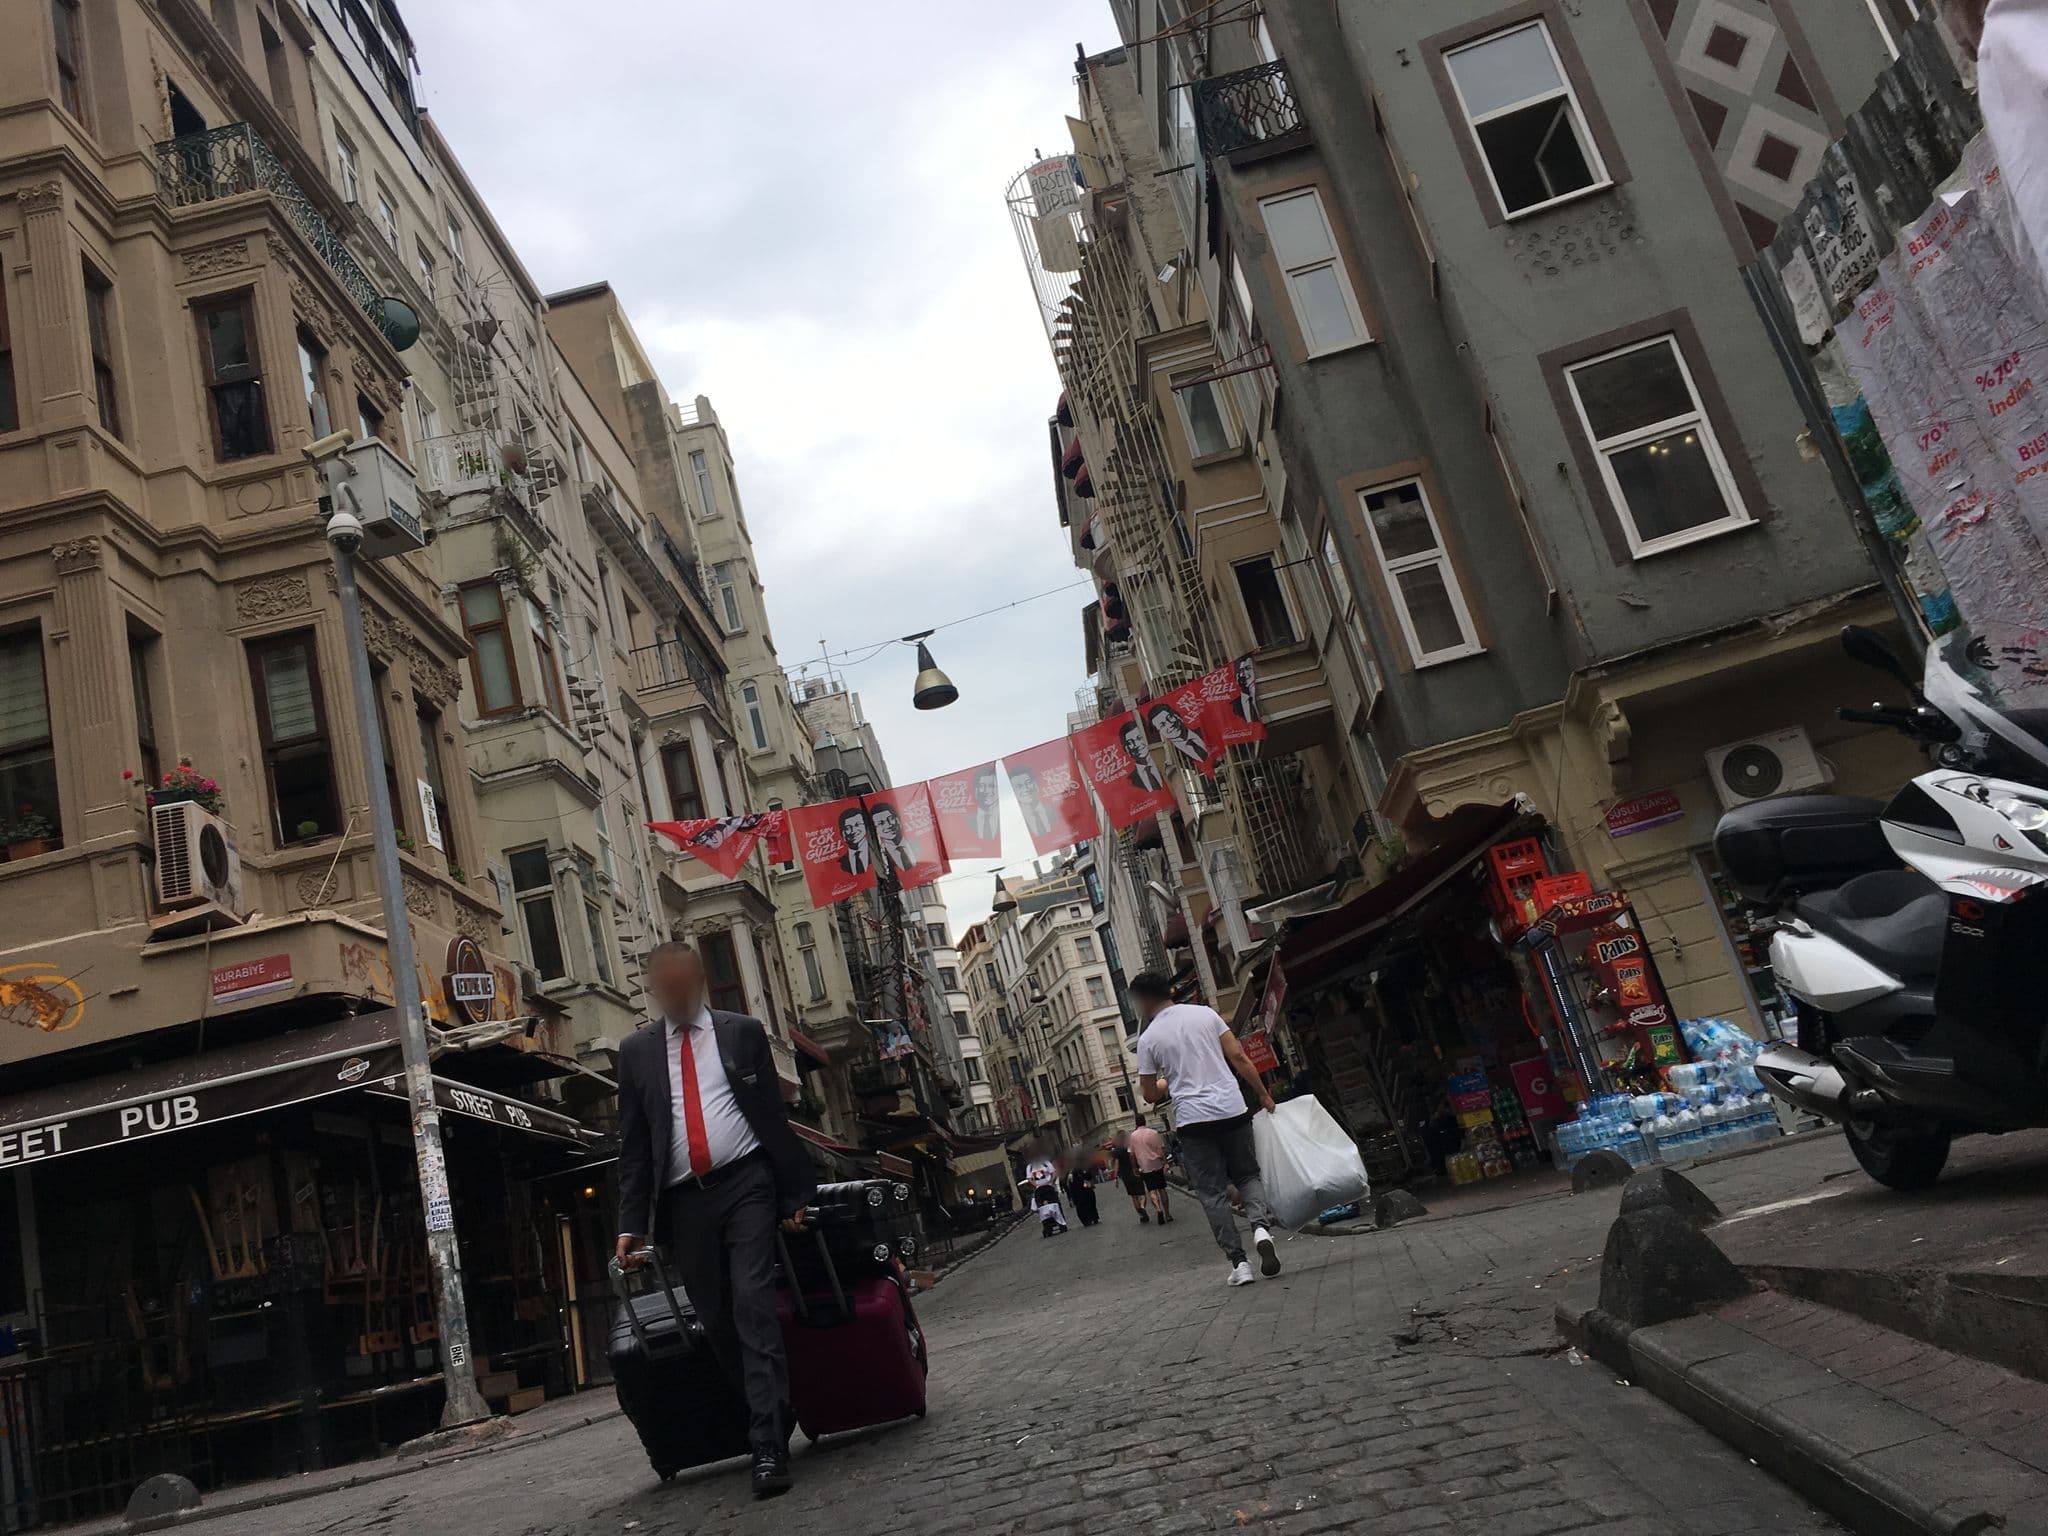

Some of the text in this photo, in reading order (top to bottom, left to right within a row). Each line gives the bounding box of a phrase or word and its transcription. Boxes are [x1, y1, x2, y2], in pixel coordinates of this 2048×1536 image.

[120, 1095, 200, 1137] PUB
[450, 1089, 532, 1128] STREET PUB
